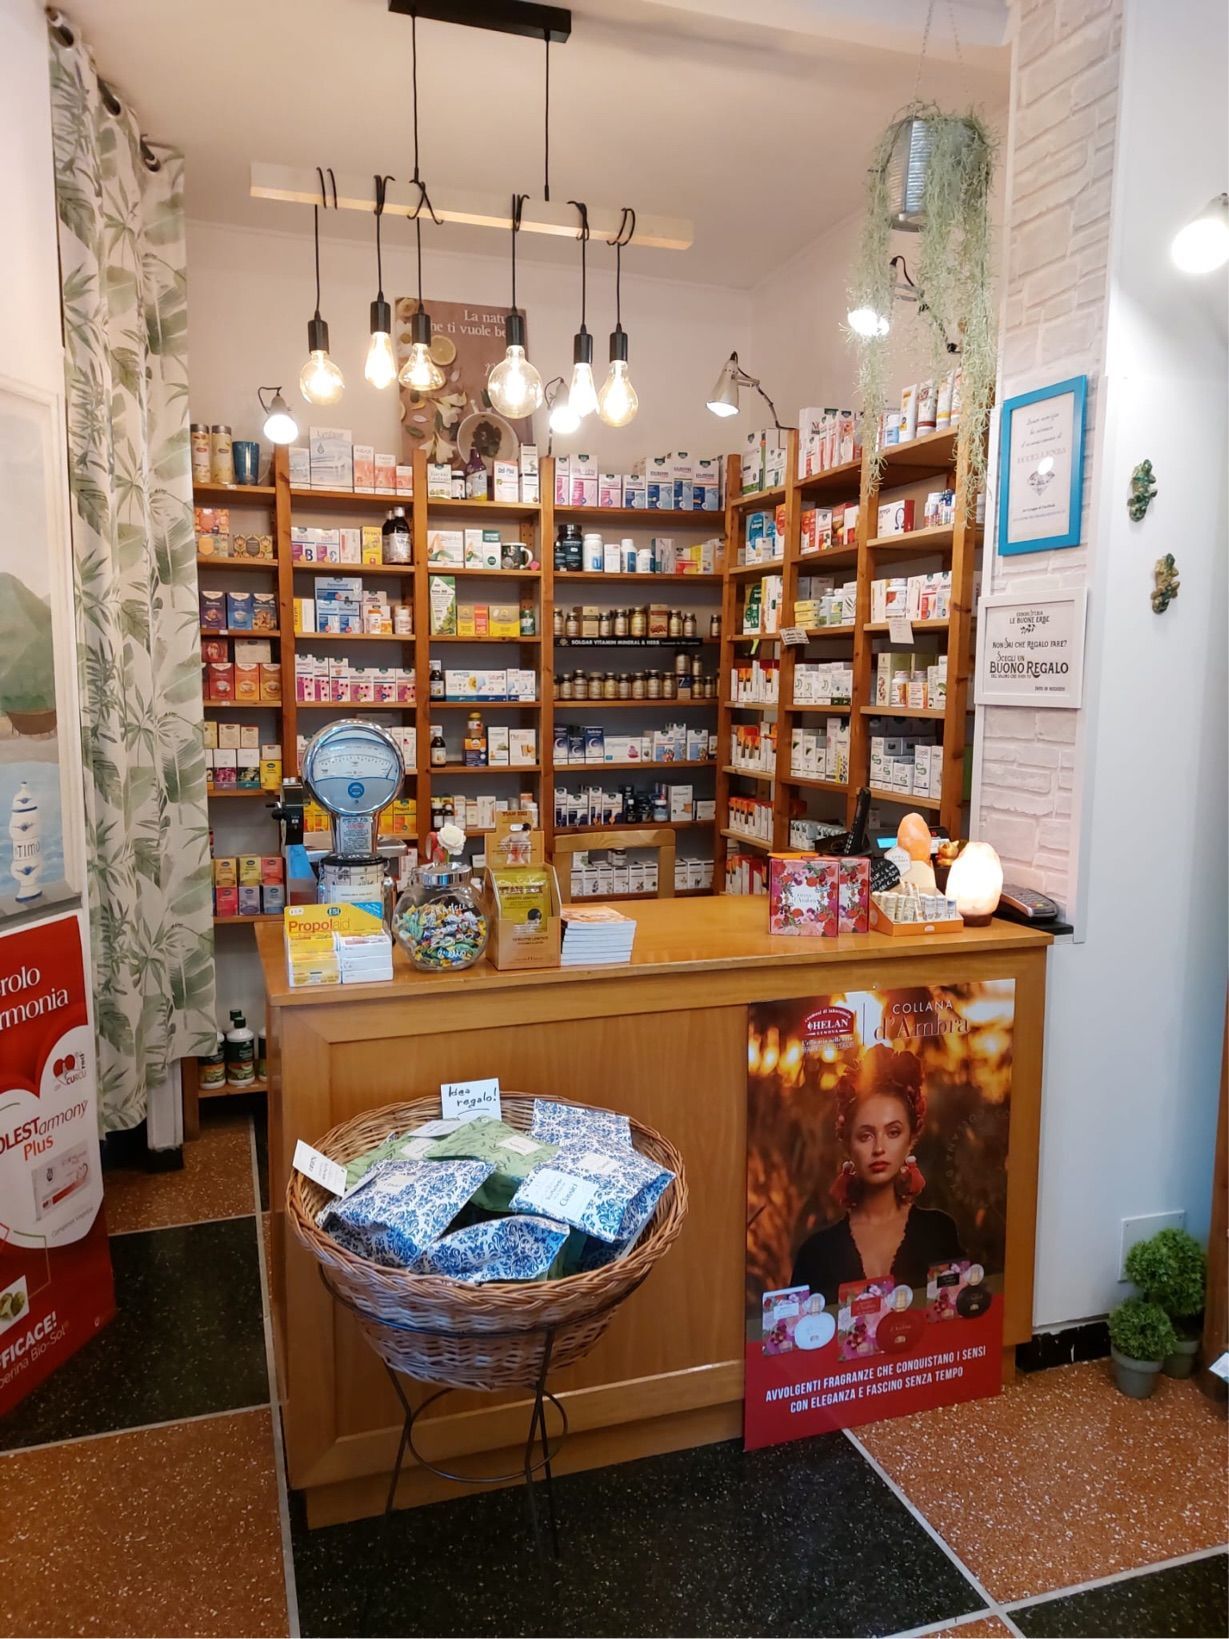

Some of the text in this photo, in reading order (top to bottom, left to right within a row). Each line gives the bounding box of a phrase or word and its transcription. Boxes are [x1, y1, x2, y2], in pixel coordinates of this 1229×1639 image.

[464, 309, 479, 322] La
[447, 321, 456, 334] ti
[460, 324, 492, 337] vuole
[1016, 616, 1035, 624] BUONE
[989, 661, 1069, 679] BUONO REGALO
[0, 966, 41, 997] rolo
[892, 1000, 954, 1015] COLLANA
[813, 1018, 849, 1031] HELAN
[456, 1087, 497, 1109] regalo!
[23, 1135, 54, 1162] Plus
[0, 1311, 57, 1370] FICACE!
[765, 1345, 987, 1402] AVVOLGENTI FRAGRANZE CHE CONQUISTANO I SENSI
[790, 1366, 964, 1414] CON ELEGANZA E FASCINO SENZA TEMPO
